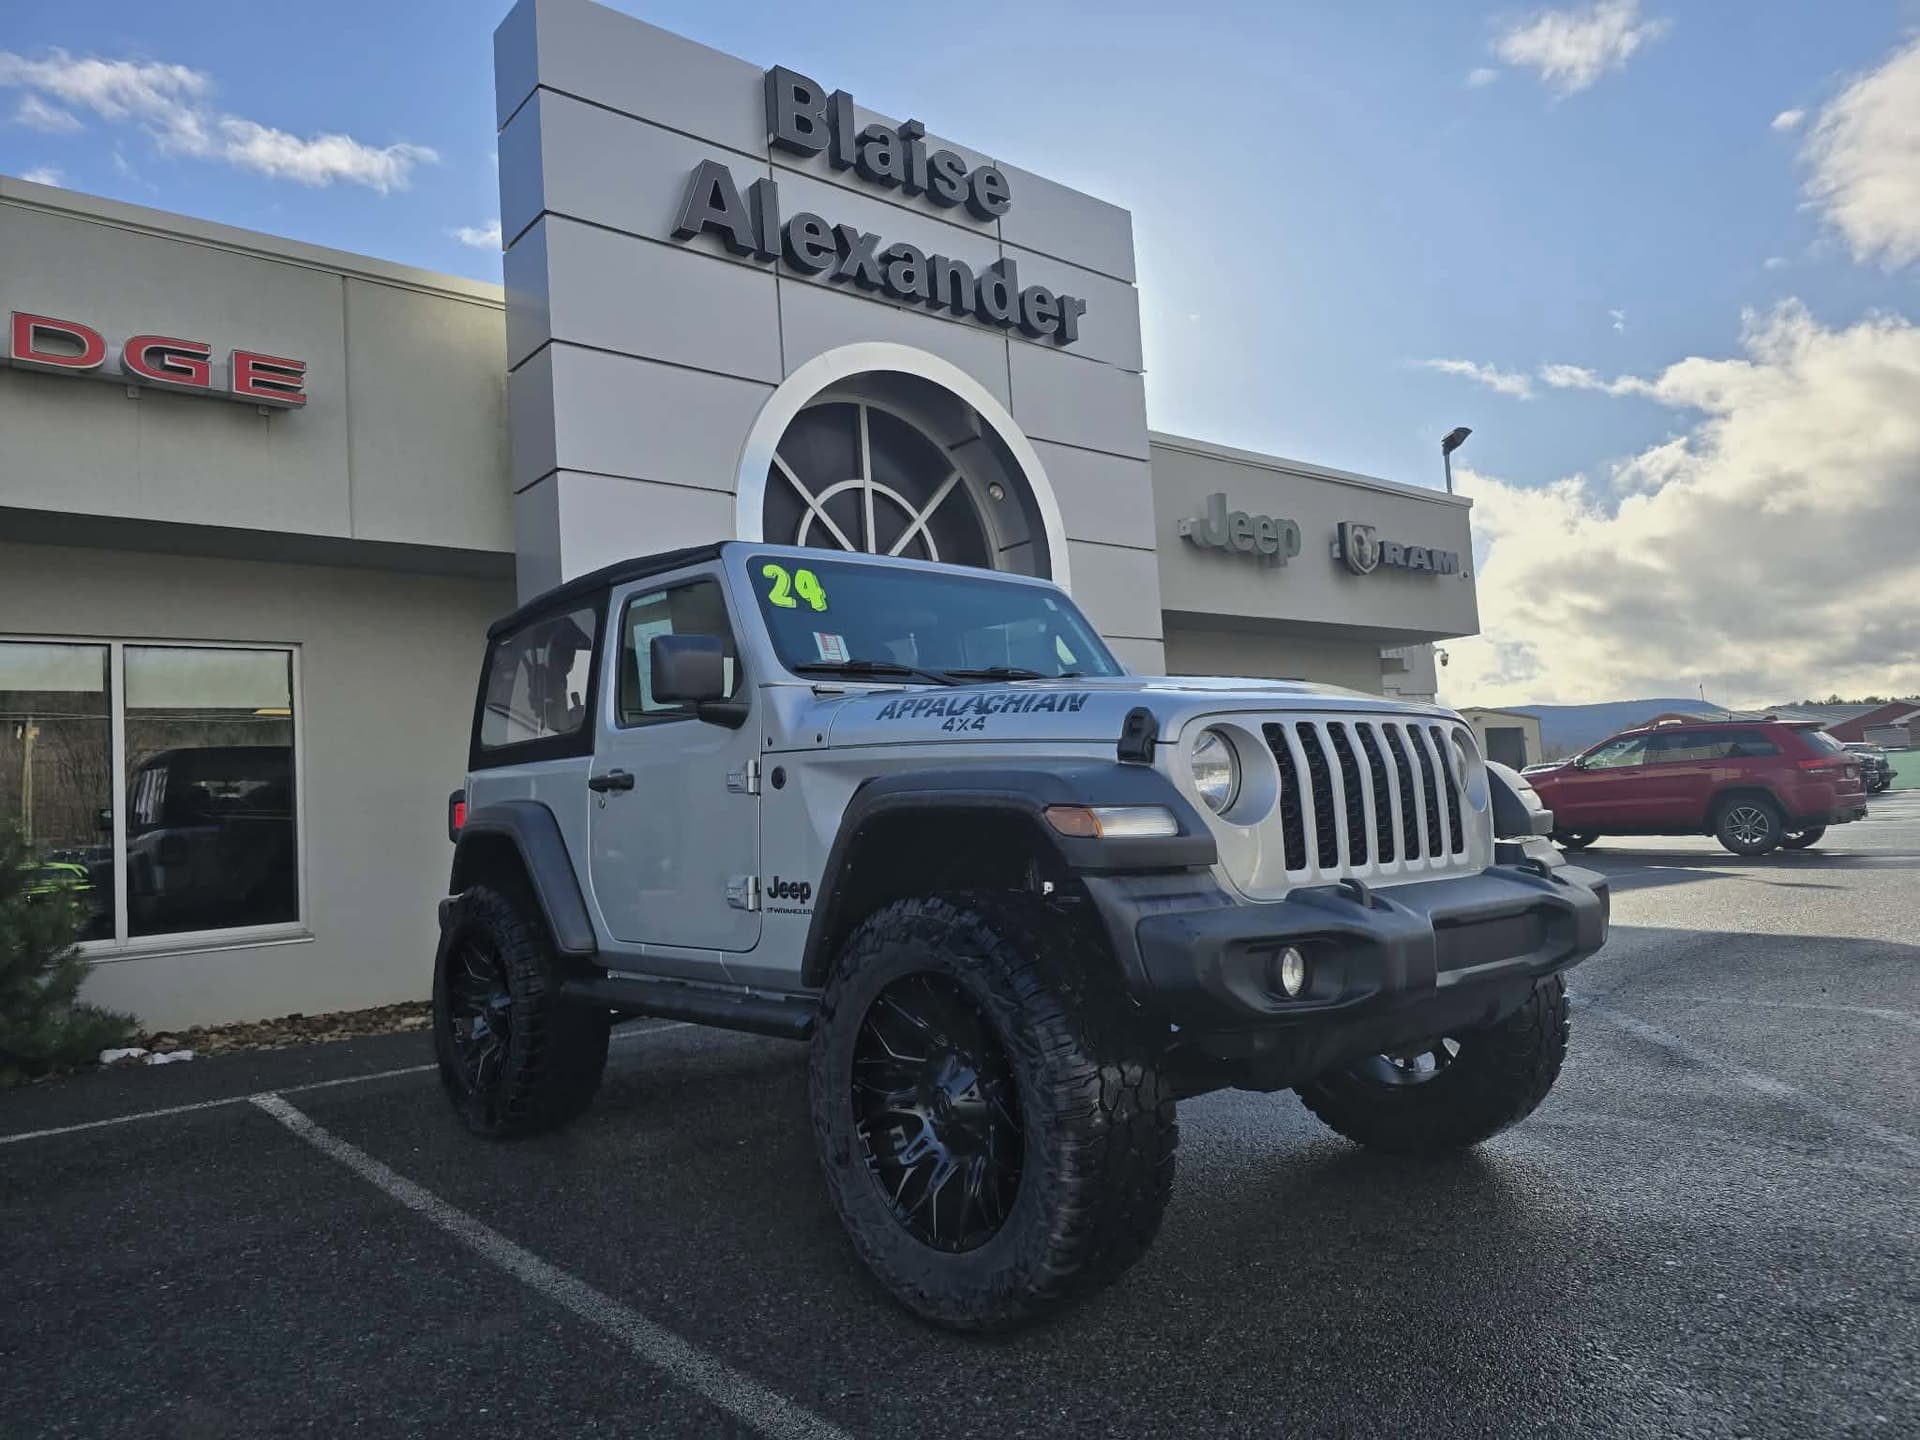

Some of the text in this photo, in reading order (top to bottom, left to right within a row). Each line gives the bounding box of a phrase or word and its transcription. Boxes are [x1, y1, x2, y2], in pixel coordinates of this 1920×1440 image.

[765, 65, 1011, 221] Blaise
[671, 159, 1087, 345] Alexander
[1190, 492, 1301, 567] Jeep
[1379, 540, 1460, 575] RAM
[762, 564, 828, 612] 24
[876, 692, 1092, 721] APPALACHIAN
[767, 875, 811, 904] Jeep
